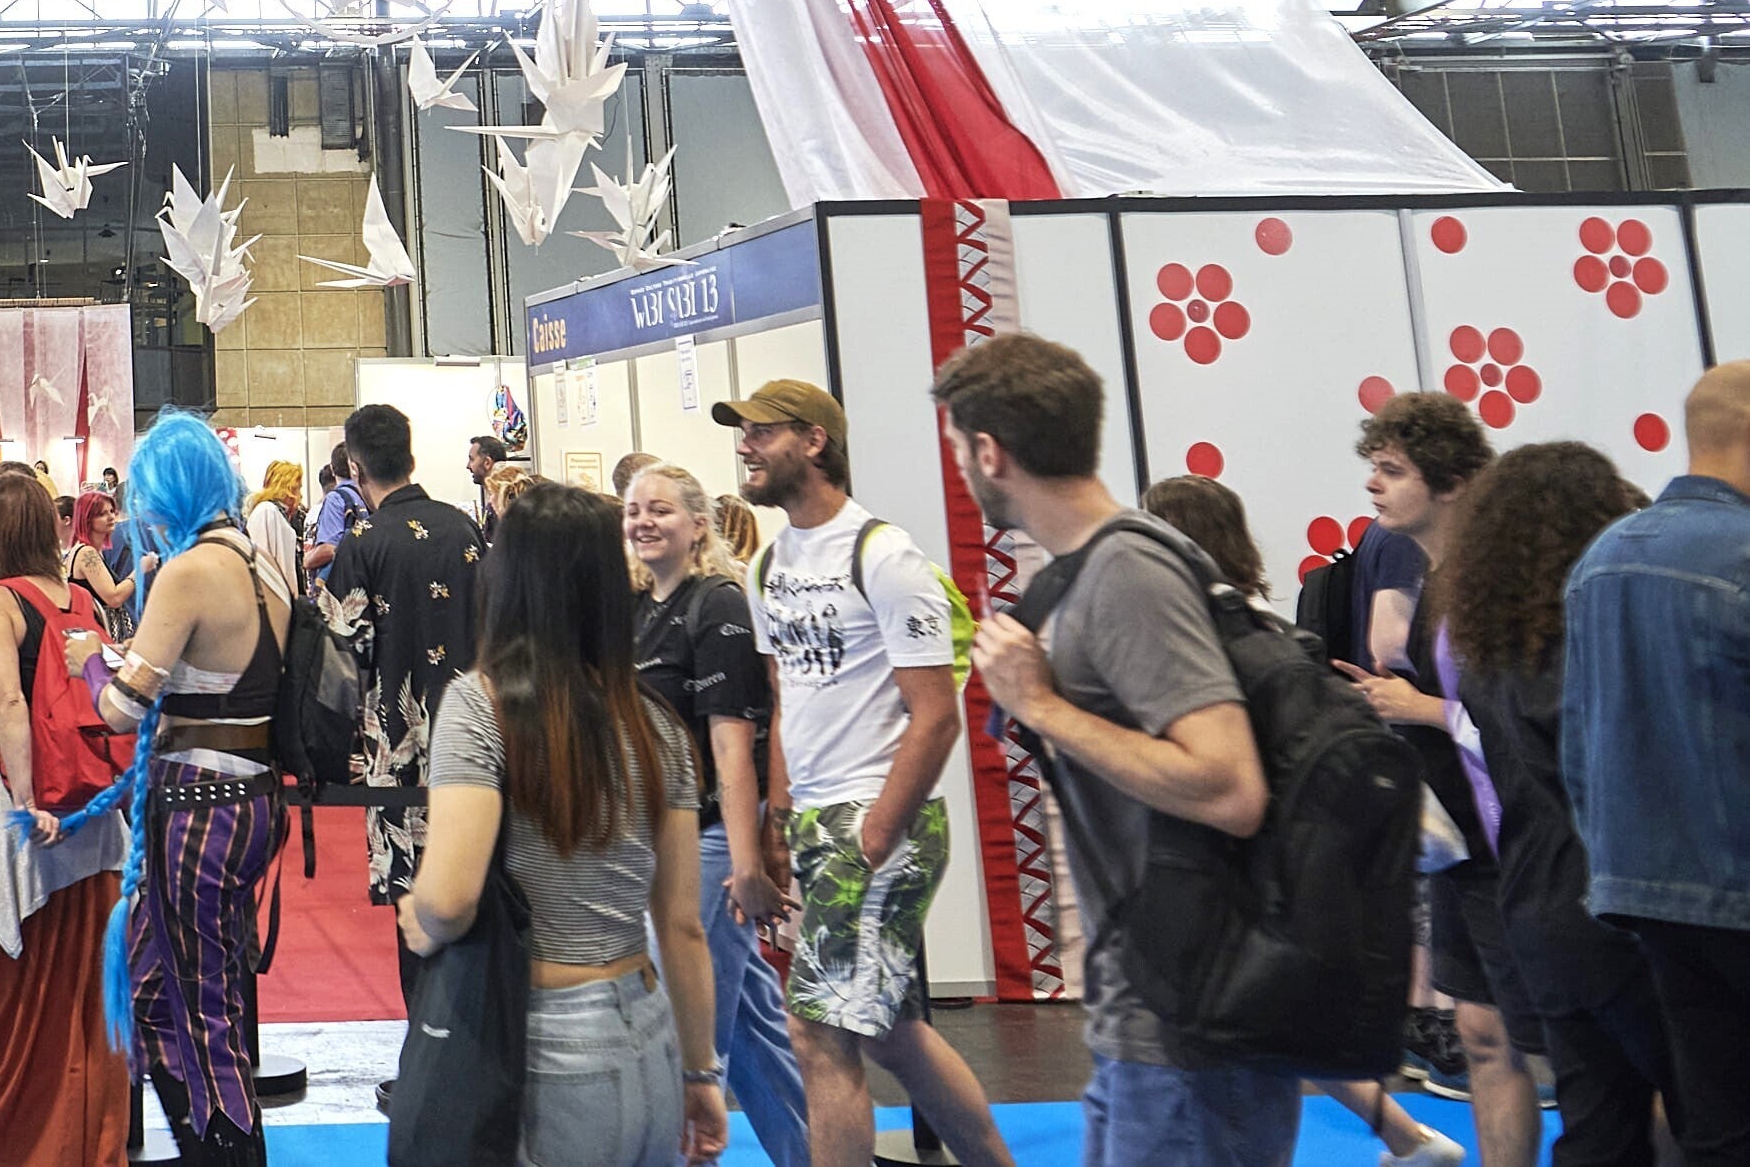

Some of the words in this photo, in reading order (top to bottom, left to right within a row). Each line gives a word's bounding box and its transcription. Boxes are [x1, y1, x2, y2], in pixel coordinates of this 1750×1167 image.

[700, 274, 719, 314] 13
[532, 313, 566, 354] Caisse
[905, 615, 943, 639] 東京
